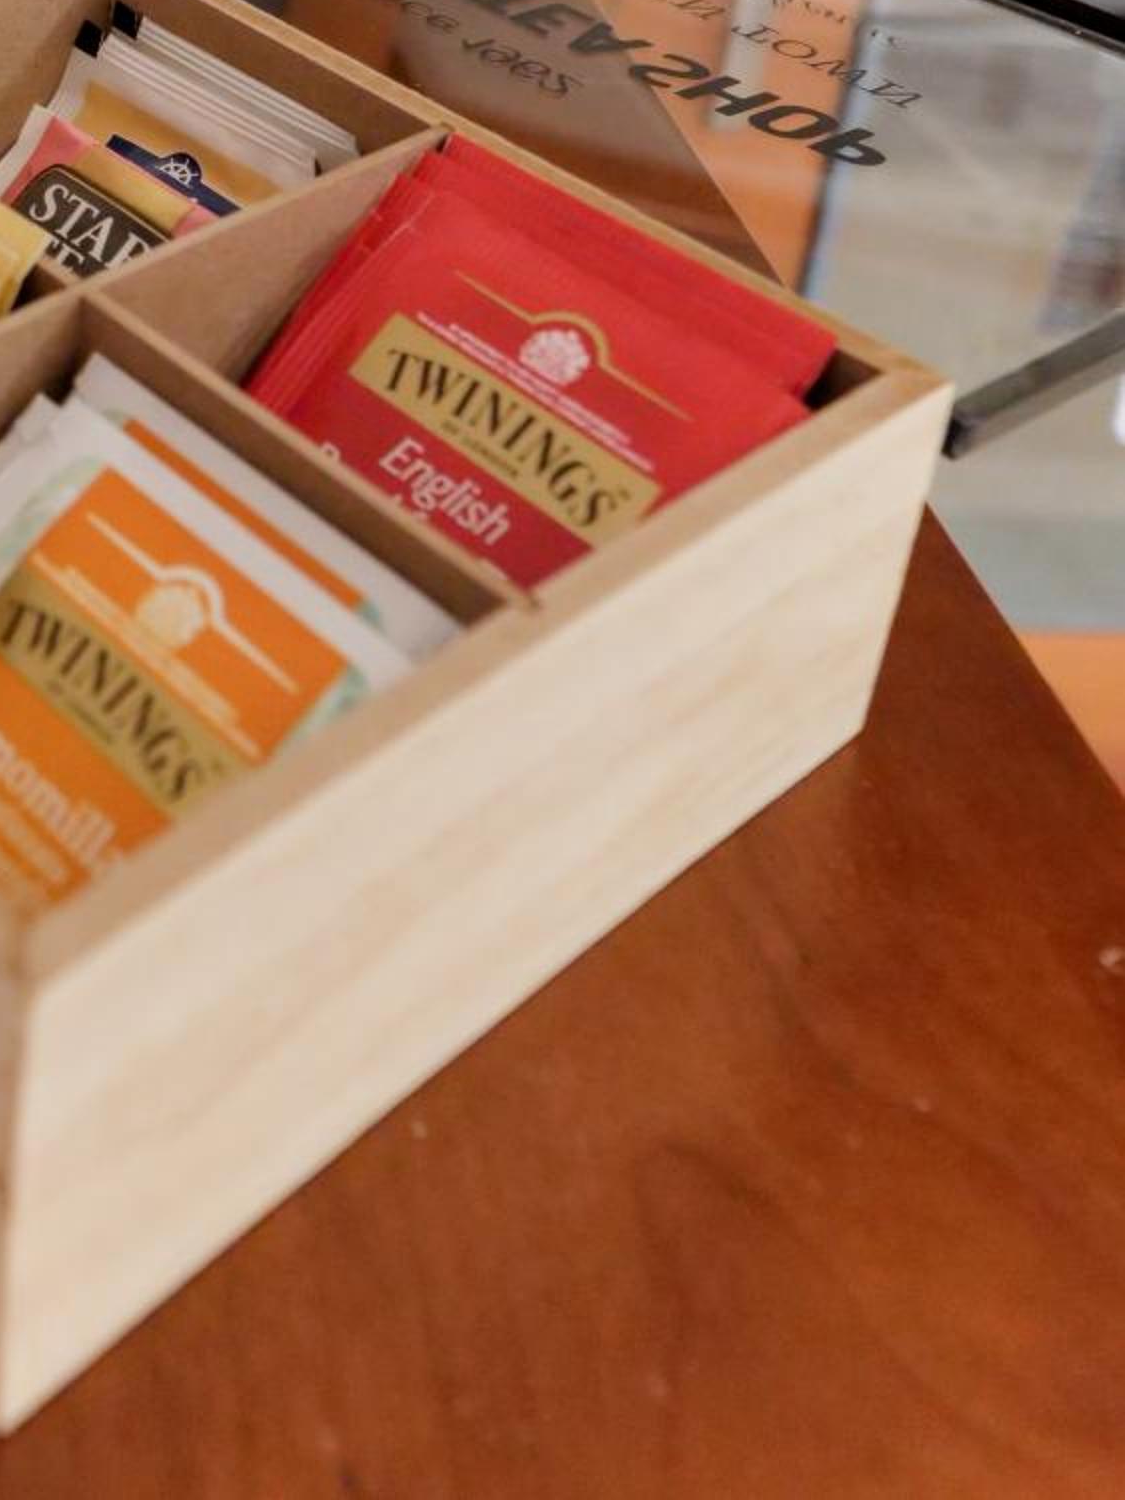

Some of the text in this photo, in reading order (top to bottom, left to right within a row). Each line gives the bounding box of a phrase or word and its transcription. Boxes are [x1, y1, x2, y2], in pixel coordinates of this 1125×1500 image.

[378, 435, 511, 546] English
[386, 348, 619, 528] TWININGS
[0, 599, 207, 802] TWININGS
